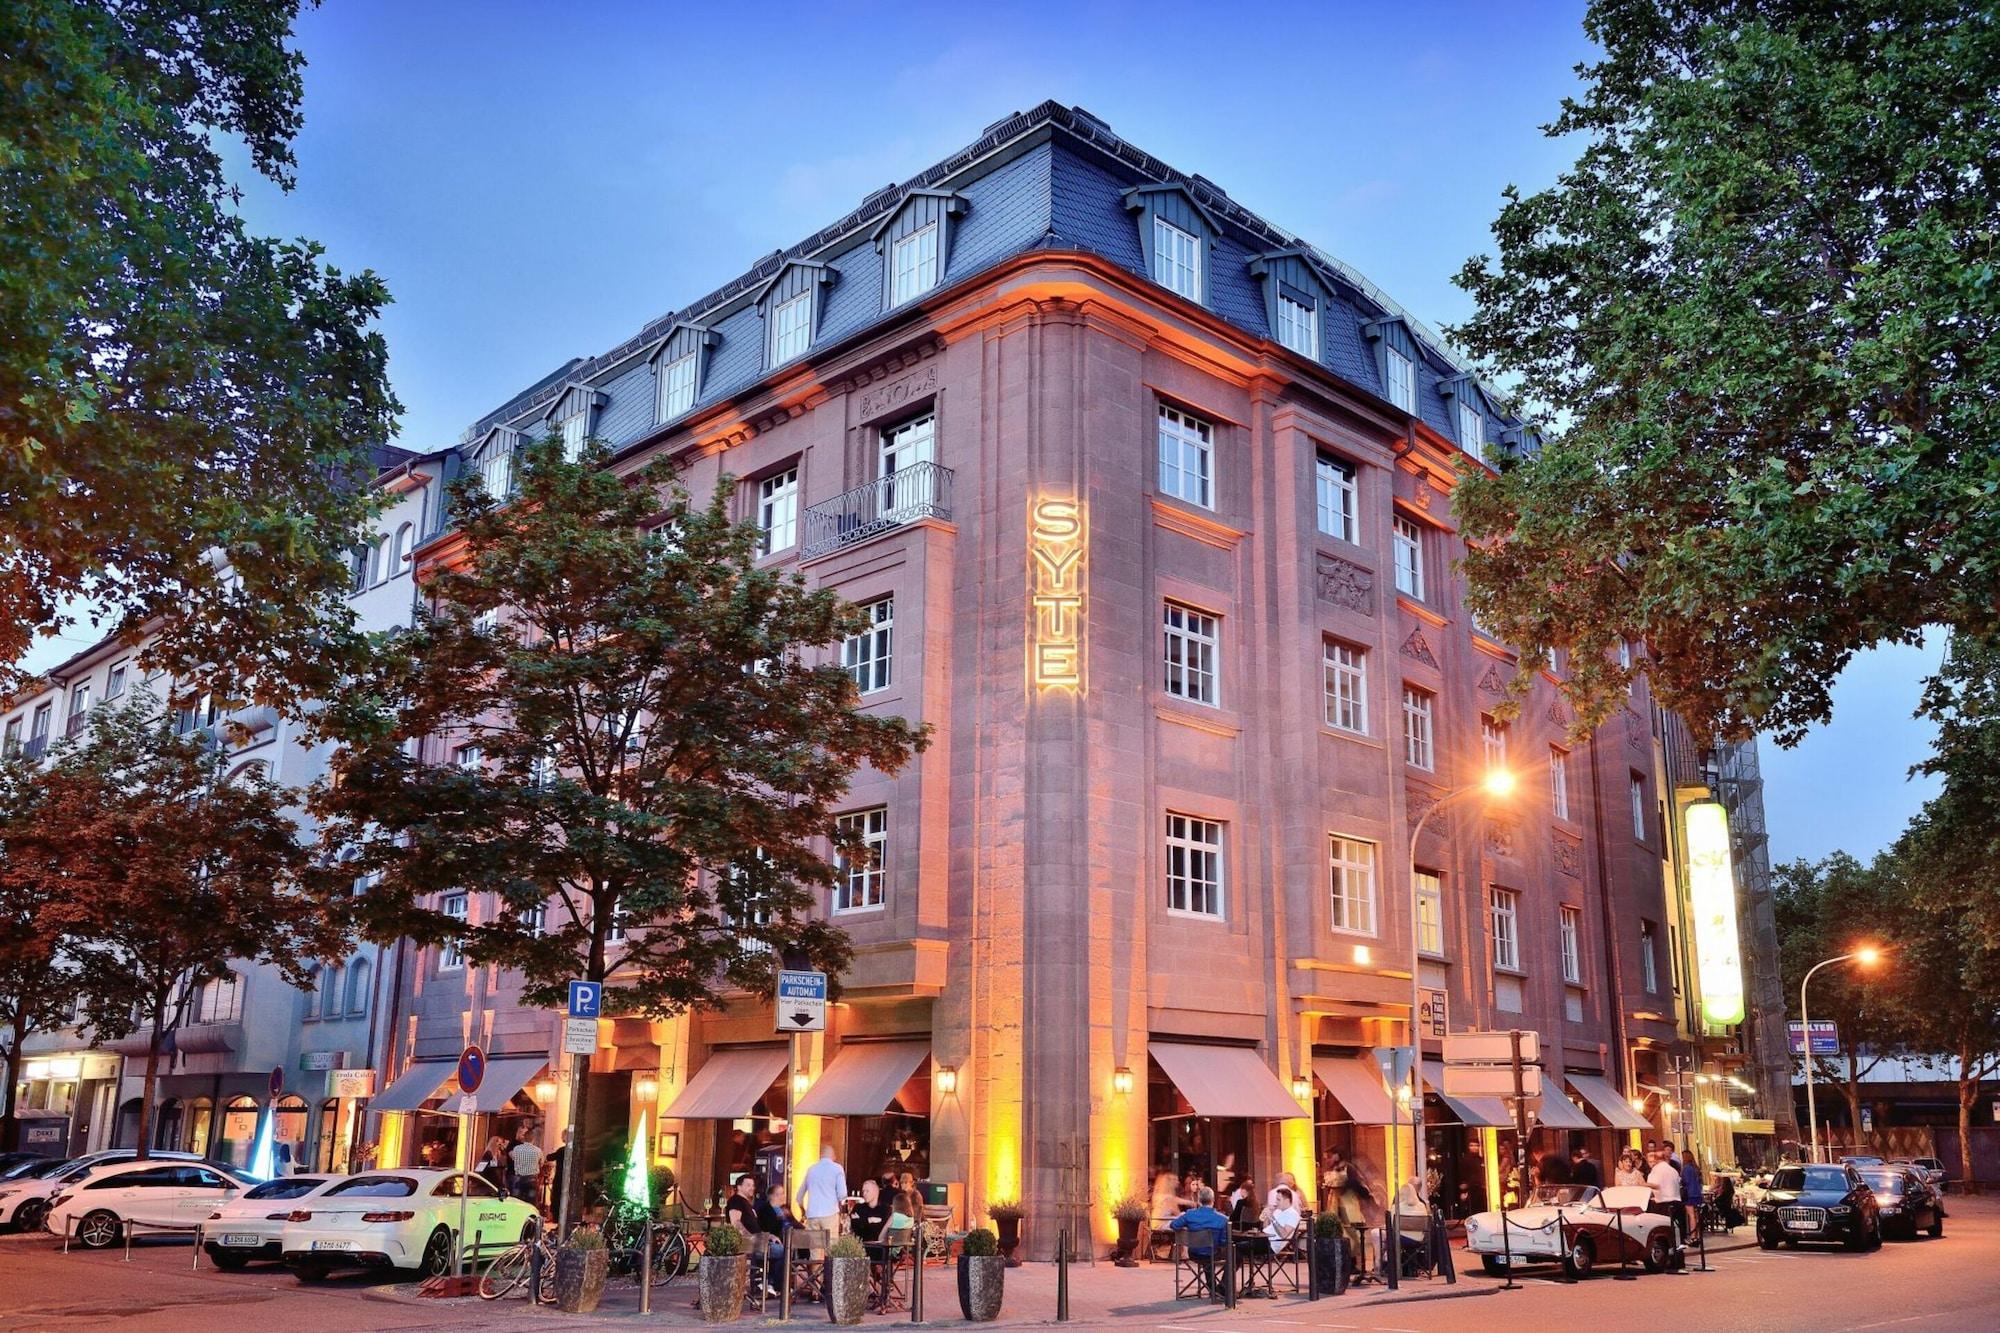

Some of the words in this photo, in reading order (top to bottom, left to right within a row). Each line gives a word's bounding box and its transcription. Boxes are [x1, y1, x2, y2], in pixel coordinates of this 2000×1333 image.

[1033, 501, 1082, 684] SYTE
[782, 975, 823, 986] PARKSCHEIN-
[576, 986, 593, 1012] P
[787, 986, 817, 997] AUTOMAT
